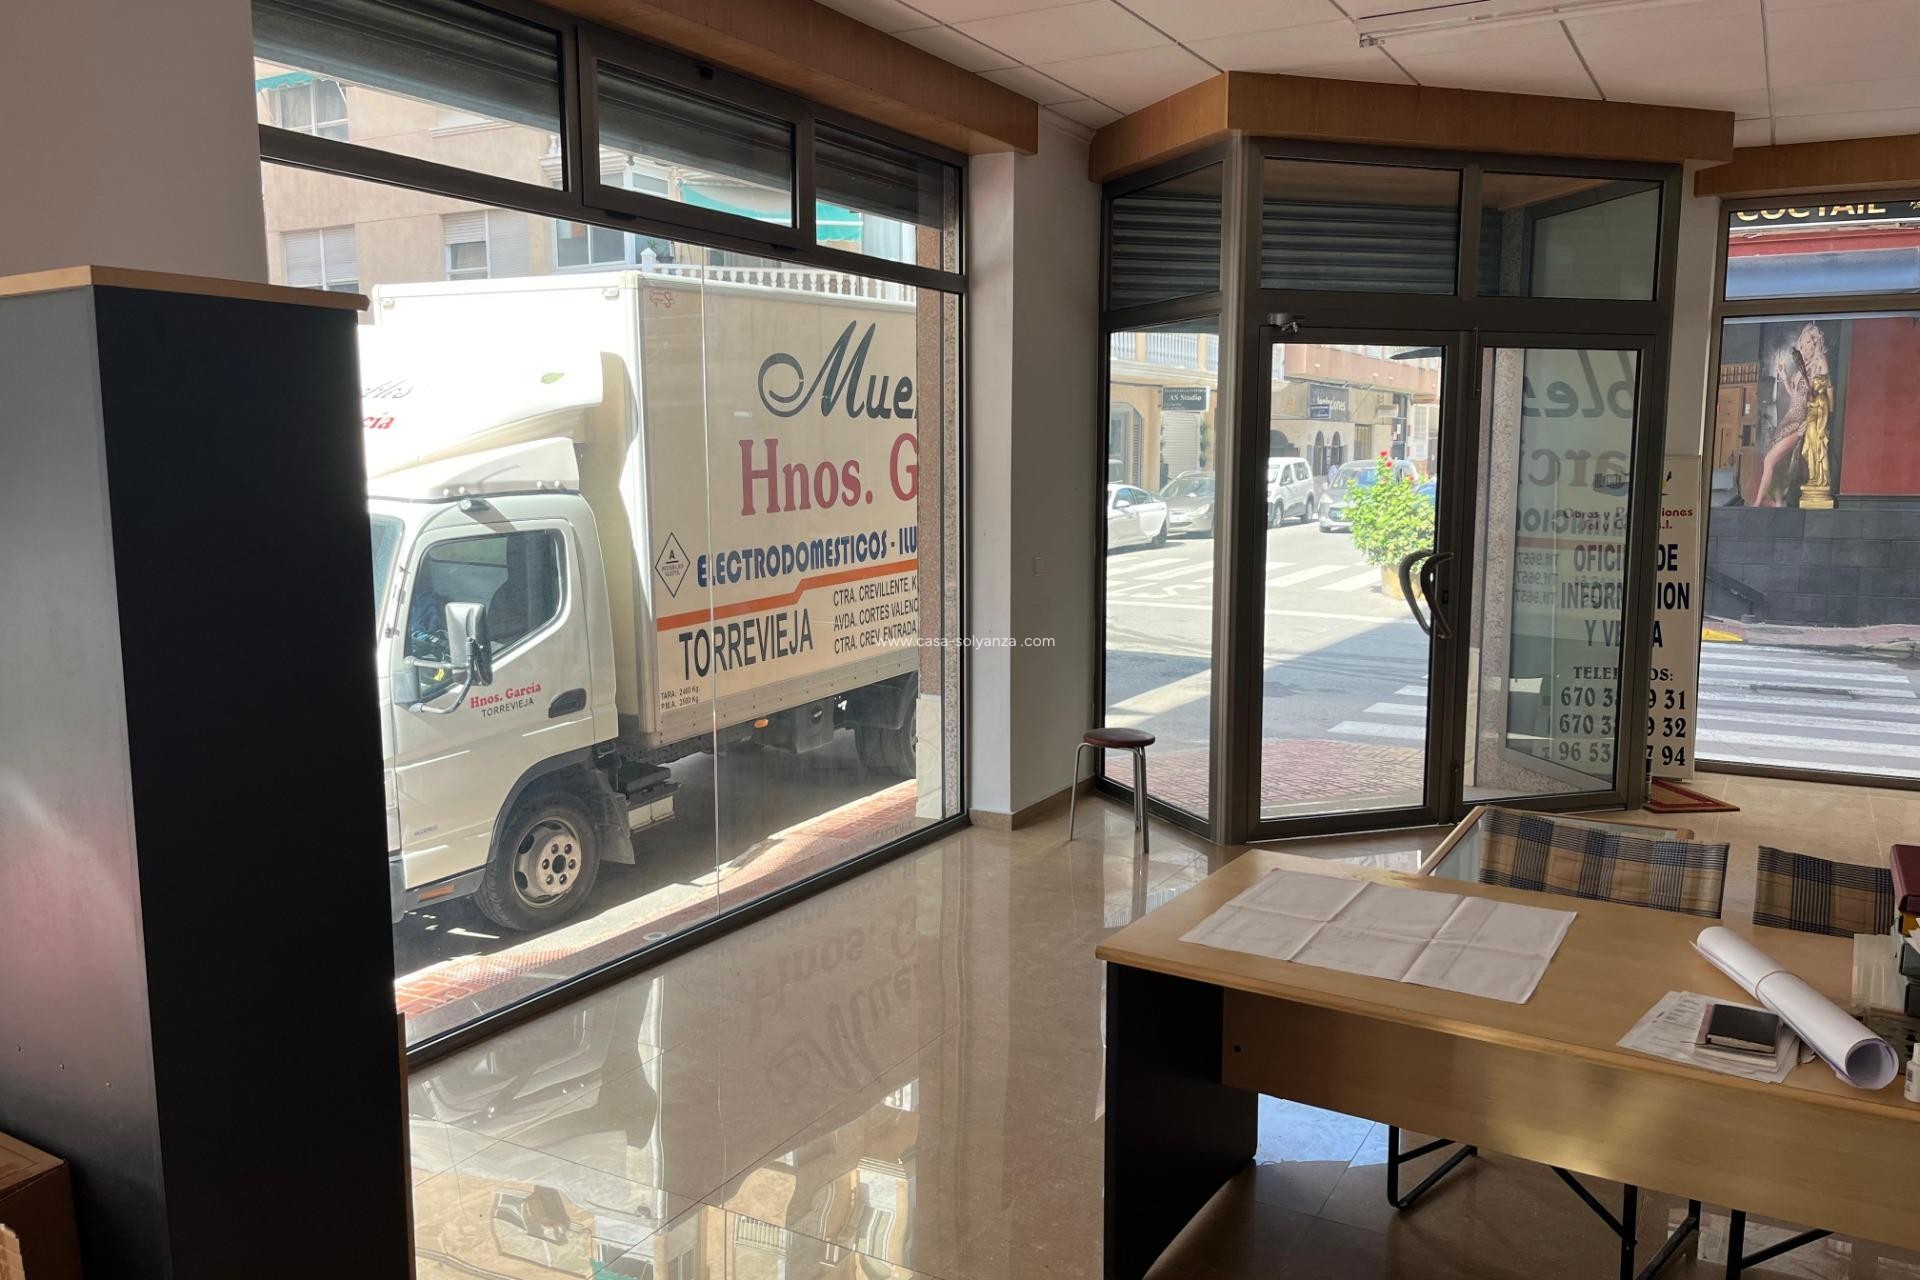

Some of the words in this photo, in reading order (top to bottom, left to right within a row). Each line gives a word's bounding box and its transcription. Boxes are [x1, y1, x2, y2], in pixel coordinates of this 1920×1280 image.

[758, 320, 917, 420] Mue
[739, 438, 873, 516] Hnos.
[697, 530, 888, 588] ELECTRODOMESTICOS
[833, 588, 856, 607] CTRA.
[833, 612, 857, 632] AVDA.
[859, 604, 890, 626] CORTES
[679, 608, 813, 681] TORREVIEJA
[834, 635, 858, 655] CTRA.
[1585, 619, 1597, 647] Y
[470, 694, 502, 710] Hnos.
[504, 682, 541, 701] García
[481, 697, 534, 718] TORREVIEJA
[1560, 686, 1596, 708] 670
[1664, 688, 1686, 710] 31
[1559, 713, 1595, 735] 670
[1662, 716, 1687, 738] 32
[1558, 741, 1582, 762] 96
[1661, 745, 1686, 767] 94
